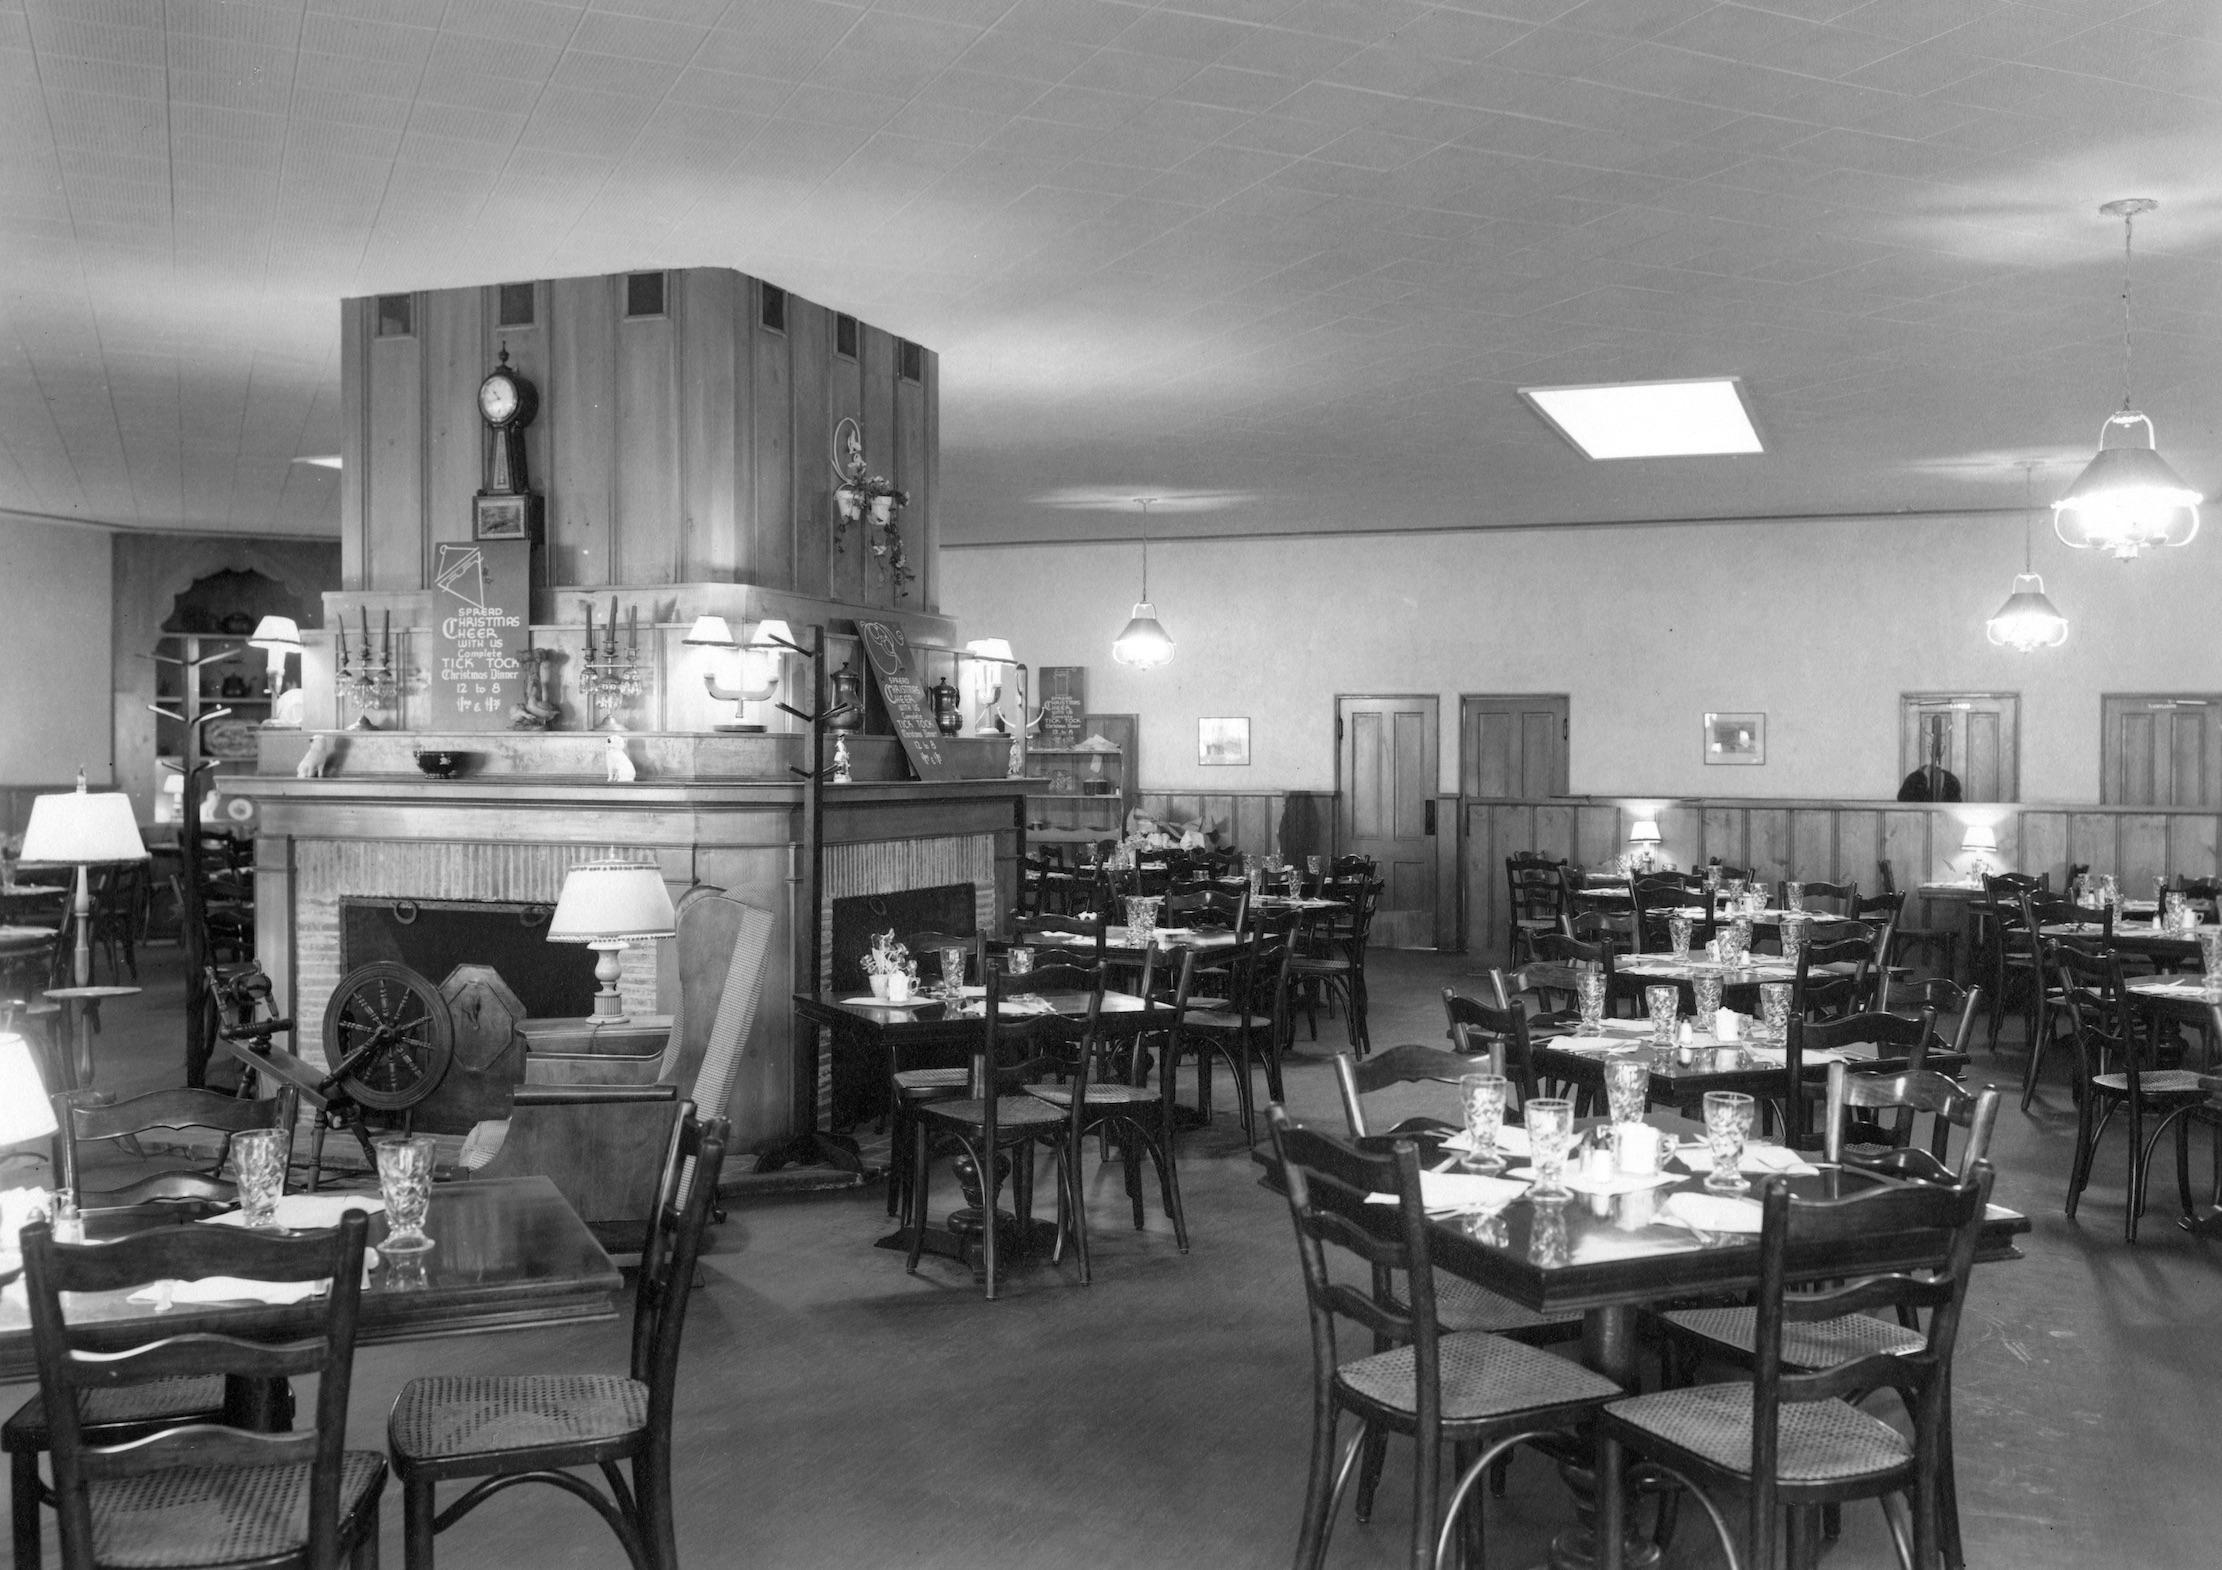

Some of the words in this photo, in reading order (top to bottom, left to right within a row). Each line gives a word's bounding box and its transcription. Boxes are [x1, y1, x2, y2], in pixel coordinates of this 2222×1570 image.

[458, 608, 503, 616] SPREAD
[442, 616, 520, 639] CHRISTMAS
[458, 639, 484, 648] WITH
[489, 639, 504, 648] US
[457, 649, 502, 659] Complete
[442, 657, 474, 669] TICK
[486, 657, 520, 669] TOCK
[441, 668, 488, 680] Christmas
[490, 668, 519, 680] Dinner
[456, 683, 468, 693] 12
[475, 683, 486, 693] to
[491, 682, 501, 694] 8
[897, 720, 914, 728] TICK
[916, 720, 934, 728] TOCK
[913, 740, 922, 749] 12
